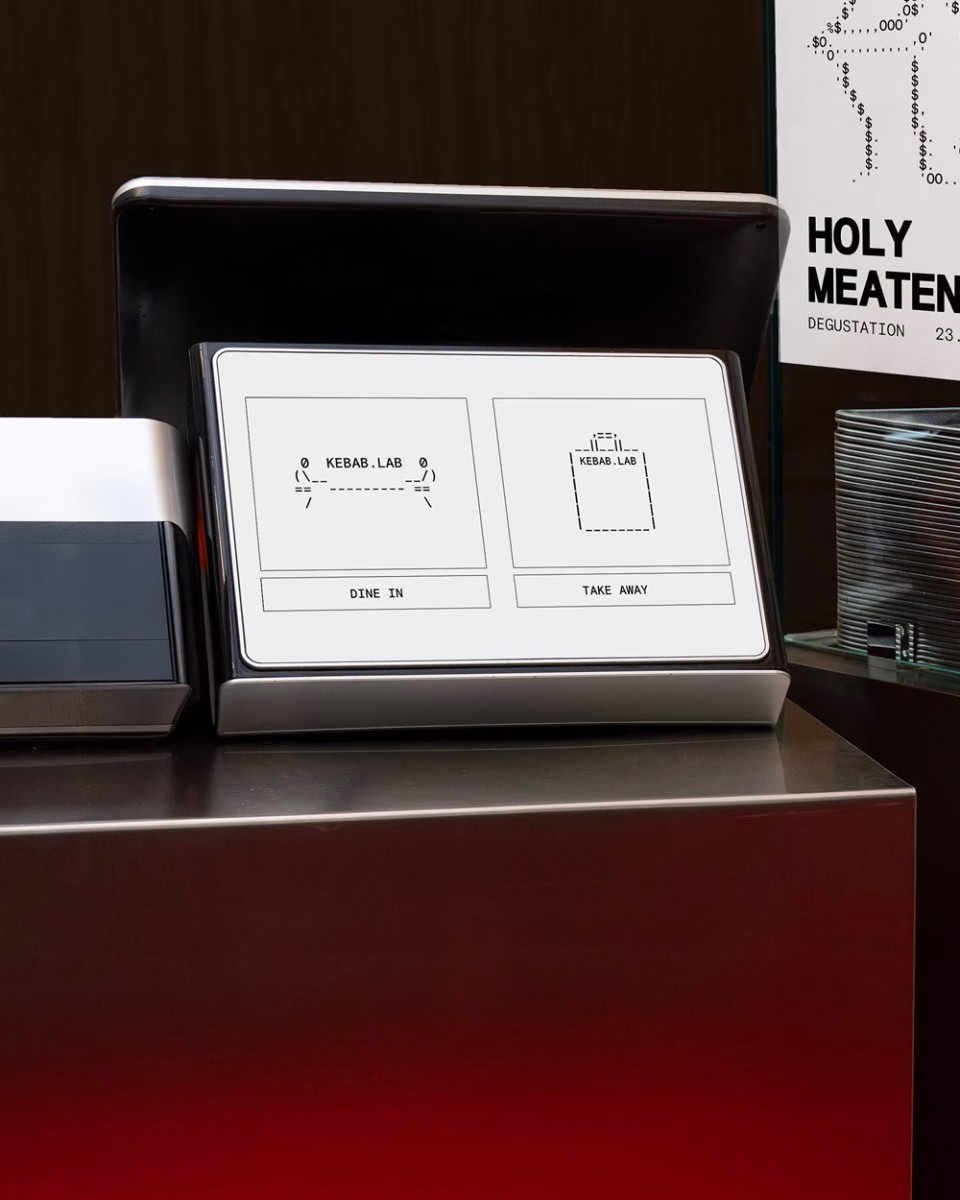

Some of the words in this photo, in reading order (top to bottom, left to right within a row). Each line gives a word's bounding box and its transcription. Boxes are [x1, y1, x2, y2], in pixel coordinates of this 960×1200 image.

[808, 216, 912, 258] HOLY
[808, 317, 905, 338] DEGUSTATION
[326, 457, 403, 469] KEBAB.LAB
[579, 456, 637, 466] KEBAB.LAB
[349, 588, 381, 599] DINE
[388, 588, 404, 599] IN
[582, 585, 612, 596] TAKE
[619, 585, 648, 595] AWAY
